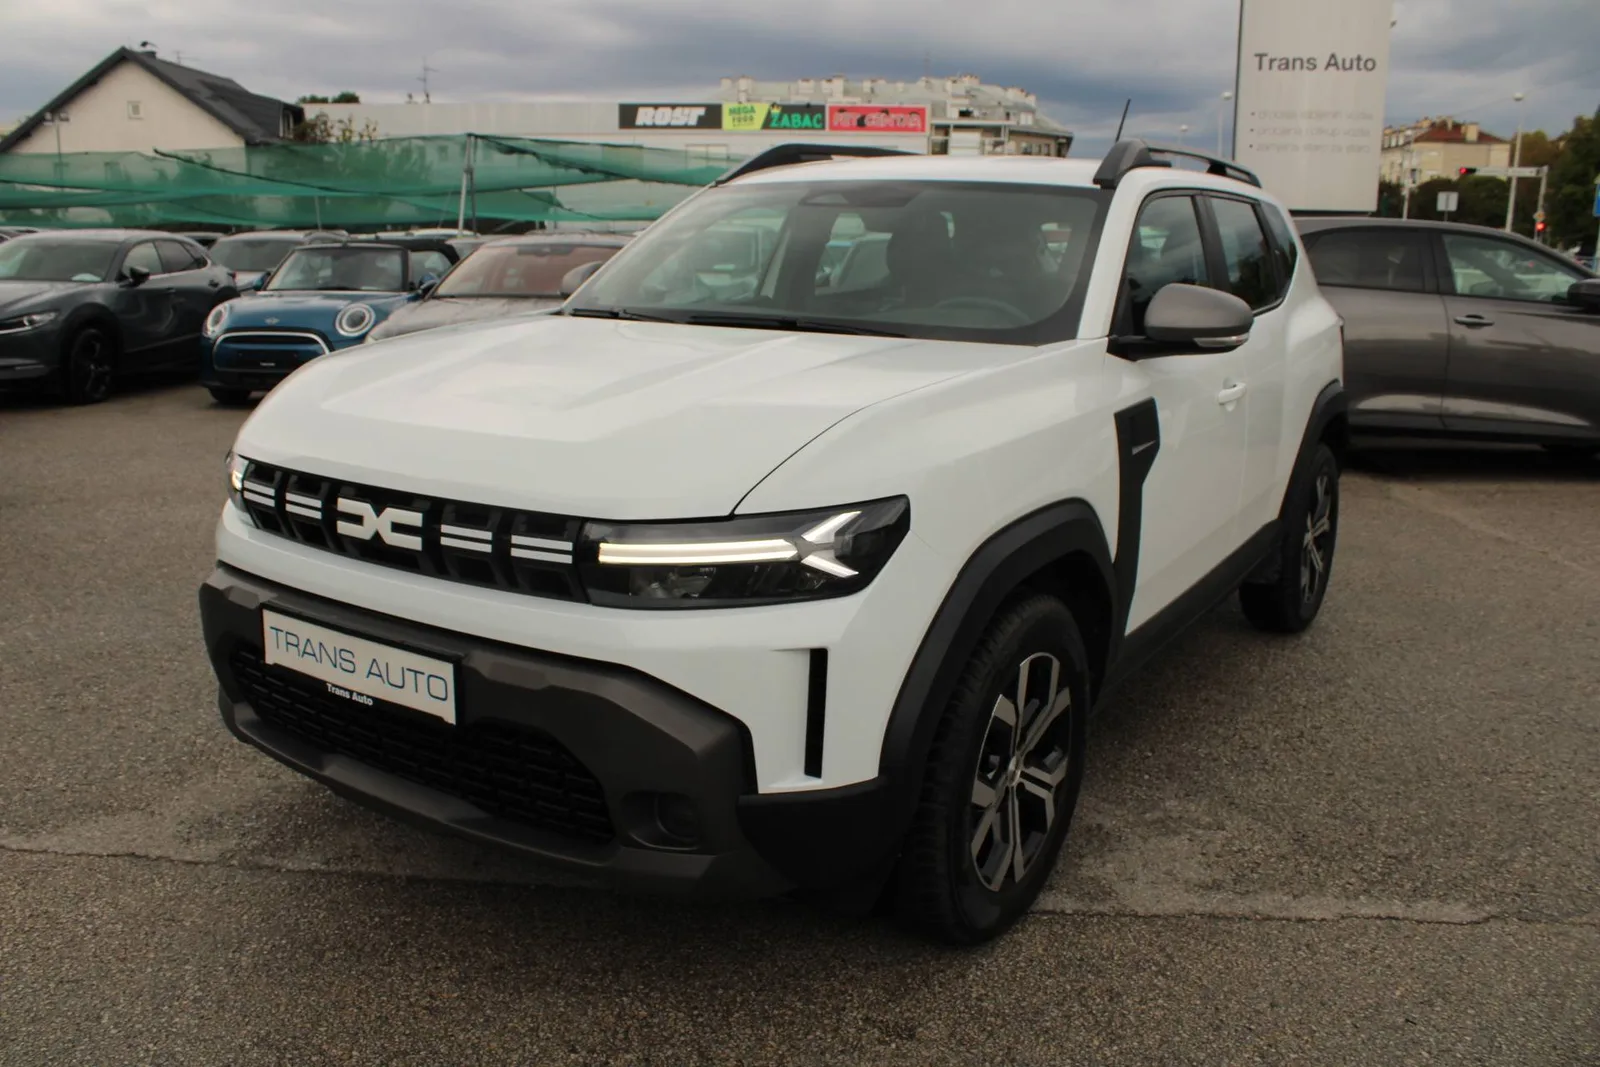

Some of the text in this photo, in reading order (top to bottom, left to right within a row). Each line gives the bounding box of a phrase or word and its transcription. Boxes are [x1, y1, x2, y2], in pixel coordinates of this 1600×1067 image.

[1254, 53, 1377, 71] Trans Auto
[269, 626, 448, 702] TRANS AUTO
[326, 683, 373, 706] Trans Auto
